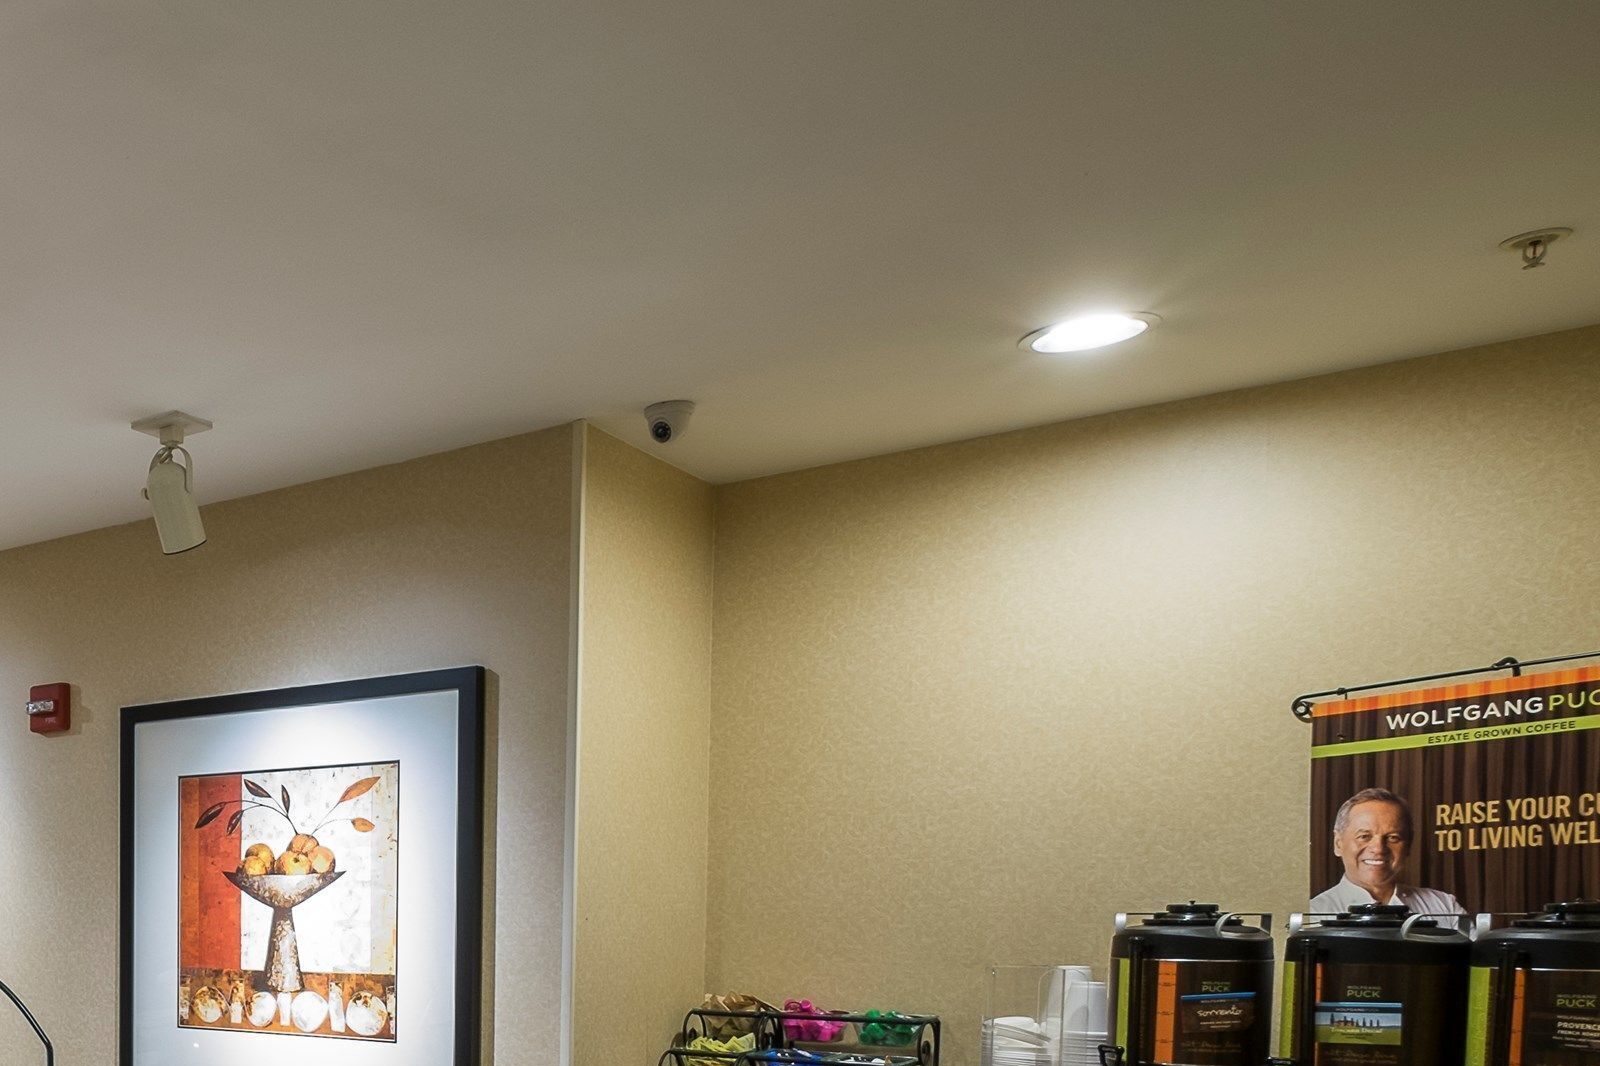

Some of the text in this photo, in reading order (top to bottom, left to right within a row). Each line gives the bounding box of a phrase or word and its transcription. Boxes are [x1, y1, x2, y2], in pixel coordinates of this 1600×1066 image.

[1386, 696, 1543, 730] WOLFGANG
[1428, 720, 1576, 744] ESTATE GROWN COFFEE
[1435, 801, 1500, 826] RAISE
[1507, 795, 1571, 821] YOUR
[1434, 829, 1461, 852] TO
[1467, 824, 1543, 850] LIVING
[1202, 985, 1230, 993] PUCK
[1346, 989, 1380, 998] PUCK
[1556, 998, 1596, 1008] PUCK
